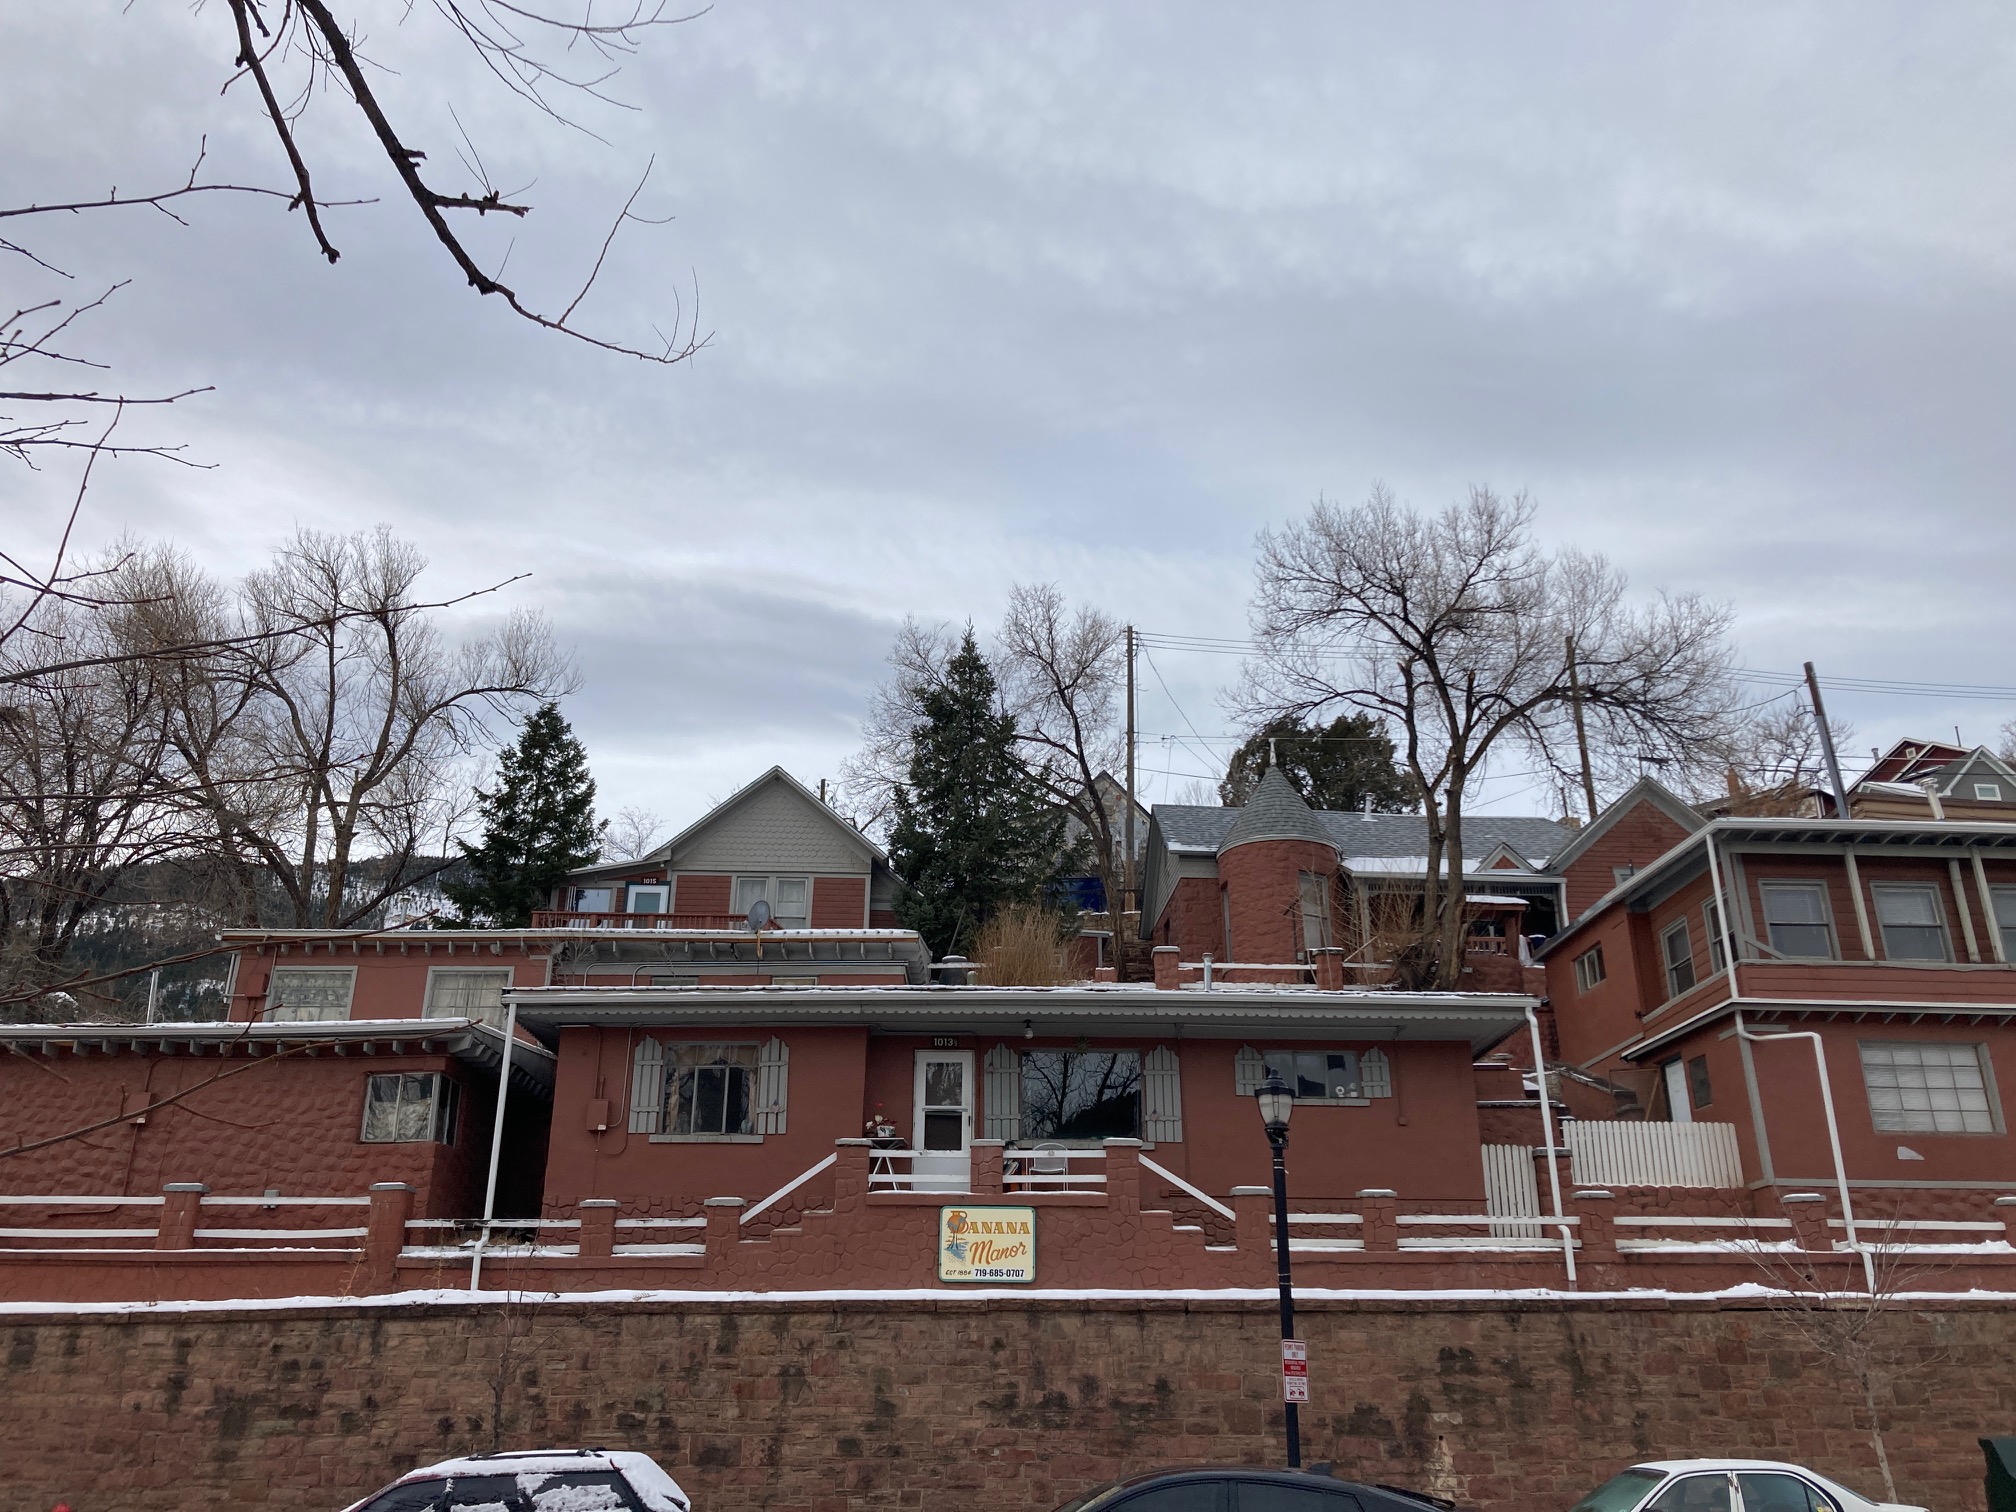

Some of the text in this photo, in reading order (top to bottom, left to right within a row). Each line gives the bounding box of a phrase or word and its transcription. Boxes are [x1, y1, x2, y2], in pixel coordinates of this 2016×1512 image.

[947, 1210, 1031, 1235] BANANA
[969, 1239, 1027, 1266] Manor
[974, 1268, 1025, 1278] 719-685-0707
